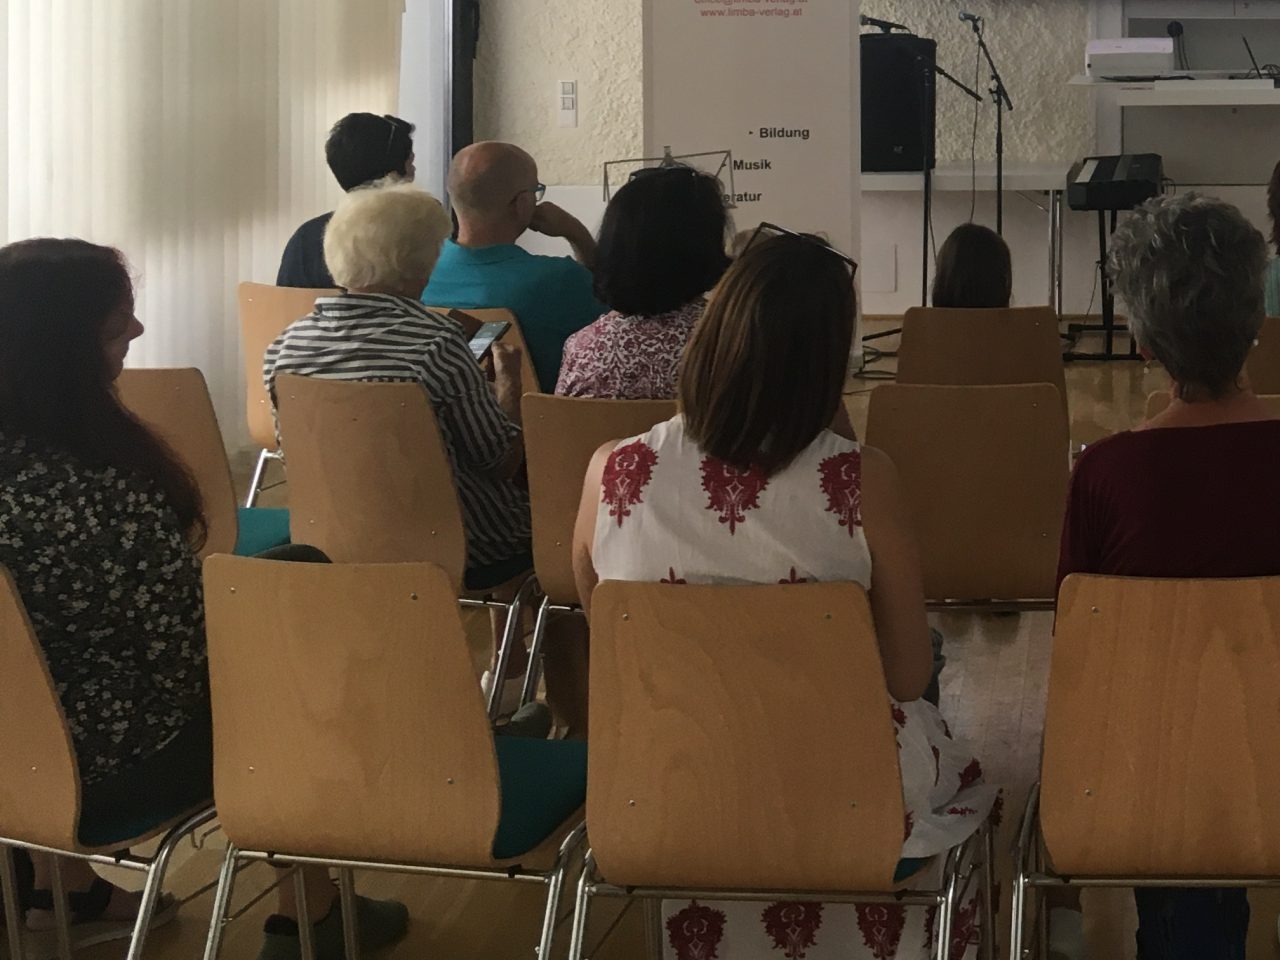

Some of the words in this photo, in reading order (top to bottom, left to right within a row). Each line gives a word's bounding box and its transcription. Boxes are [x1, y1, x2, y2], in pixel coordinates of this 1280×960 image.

[700, 7, 803, 18] www.limba-verlag.at
[759, 127, 810, 140] Bildung
[733, 159, 772, 170] Musik
[722, 191, 762, 202] eratur
